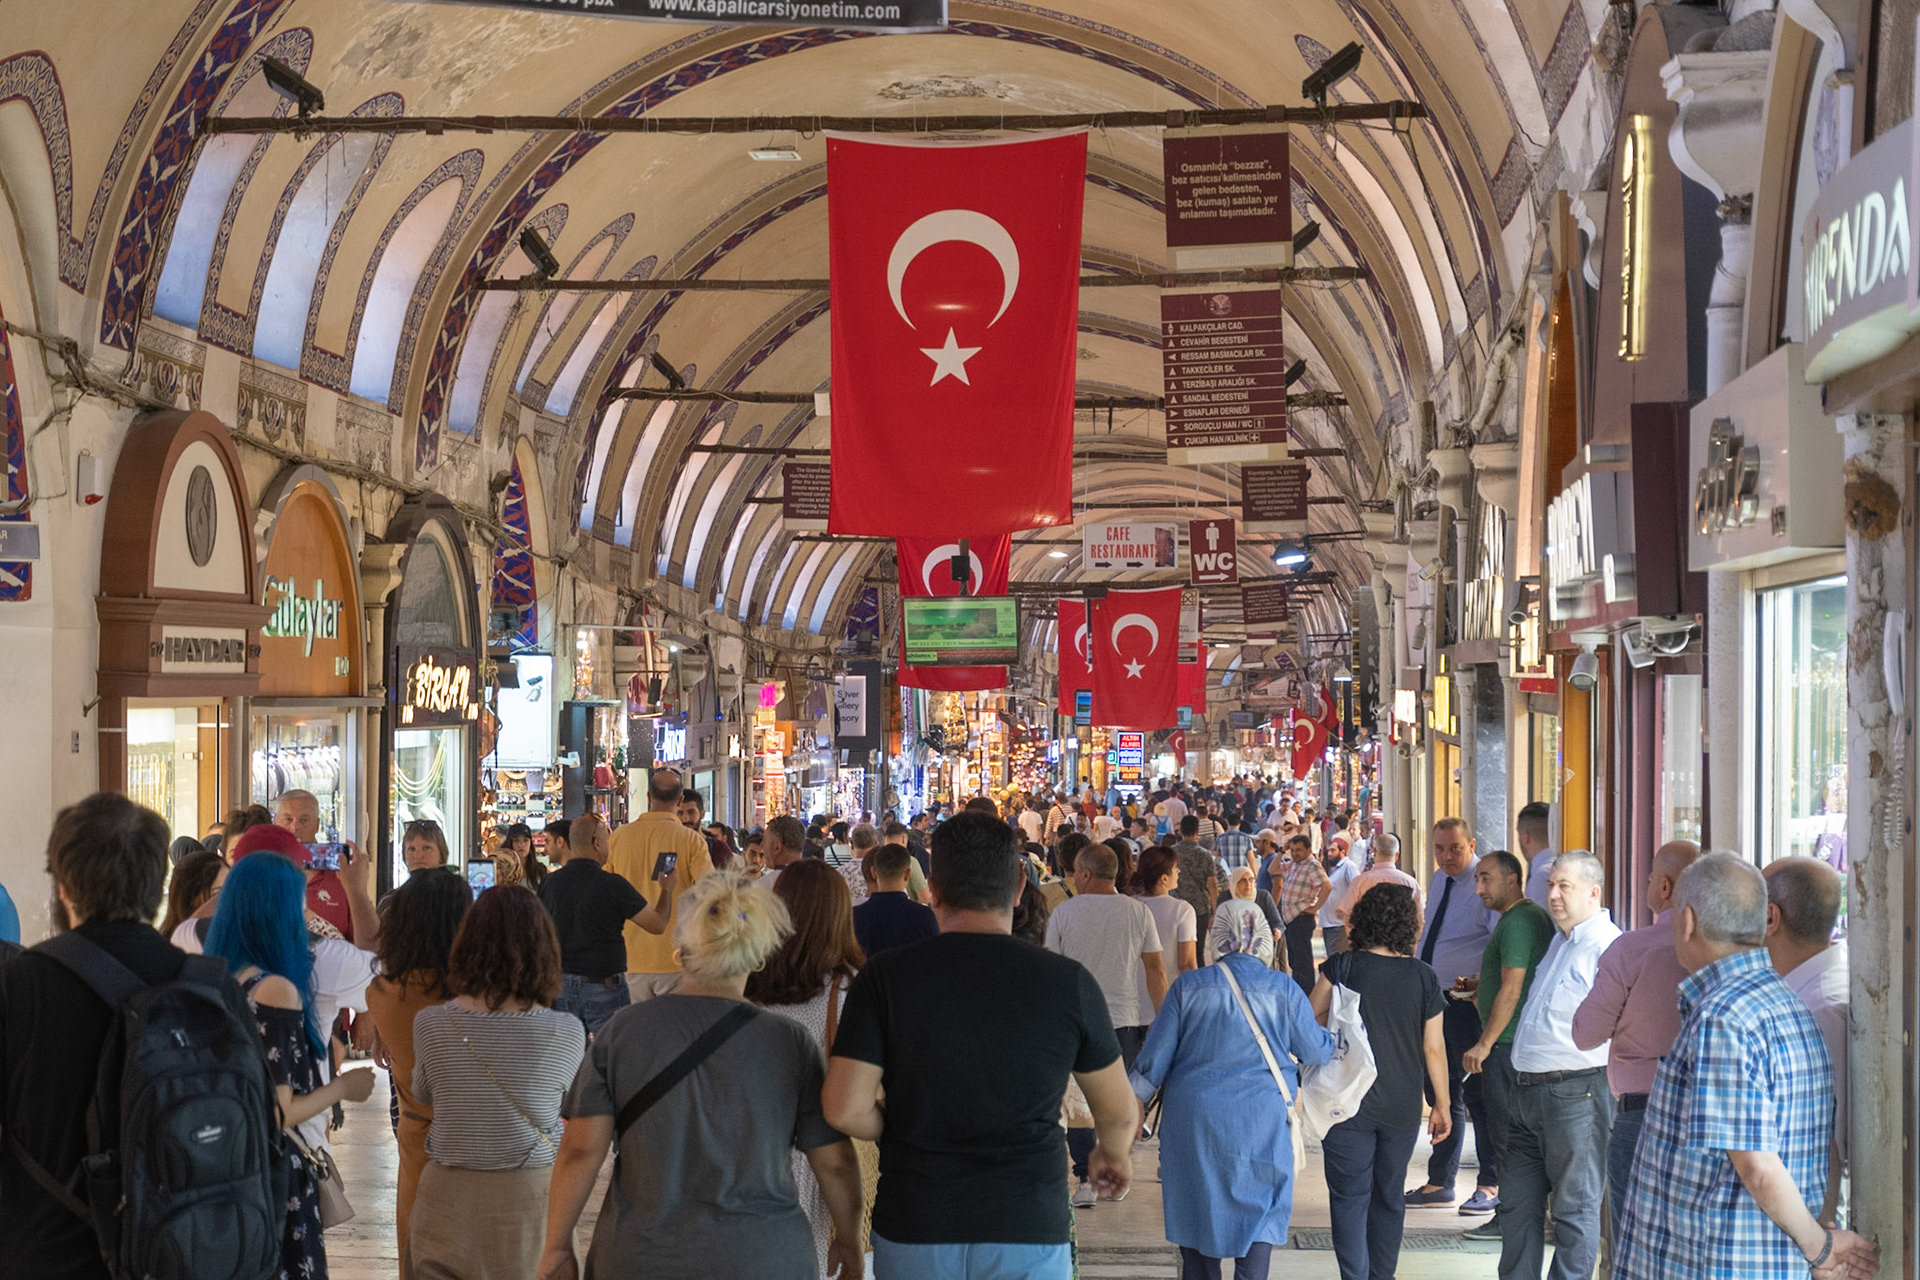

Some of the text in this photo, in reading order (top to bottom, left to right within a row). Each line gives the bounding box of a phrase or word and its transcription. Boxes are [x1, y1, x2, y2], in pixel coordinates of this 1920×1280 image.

[649, 0, 901, 21] www.kapalicarsiyonetim.com
[1181, 163, 1228, 173] Osmanlıca
[1172, 171, 1282, 185] bez satıcısı kelimesinden
[1192, 184, 1262, 197] gelen bedesten,
[1176, 195, 1279, 209] bez (kumaş) satılan yer
[1179, 207, 1277, 219] anlamını taşımaktadır.
[1180, 321, 1245, 333] KALPAKÇILAR CAD.
[1180, 335, 1249, 347] CEVAHİR BEDESTENİ
[1181, 351, 1210, 361] RESSAM
[1255, 348, 1267, 357] SK.
[1224, 364, 1237, 373] SK.
[1182, 376, 1257, 389] TERZİBAŞI ARALIĞI SK.
[1183, 391, 1249, 403] SANDAL BEDESTENİ
[1183, 405, 1250, 417] ESNAFLAR DERNEĞİ
[1184, 422, 1222, 432] SORGUÇLU
[1222, 421, 1237, 430] HAN
[1241, 419, 1253, 429] WC
[1185, 436, 1209, 446] ÇUKUR
[1106, 526, 1131, 541] CAFE
[1090, 543, 1155, 559] RESTAURANT
[1194, 552, 1235, 571] WC
[164, 636, 245, 663] HAYDAR
[837, 689, 860, 698] Slver
